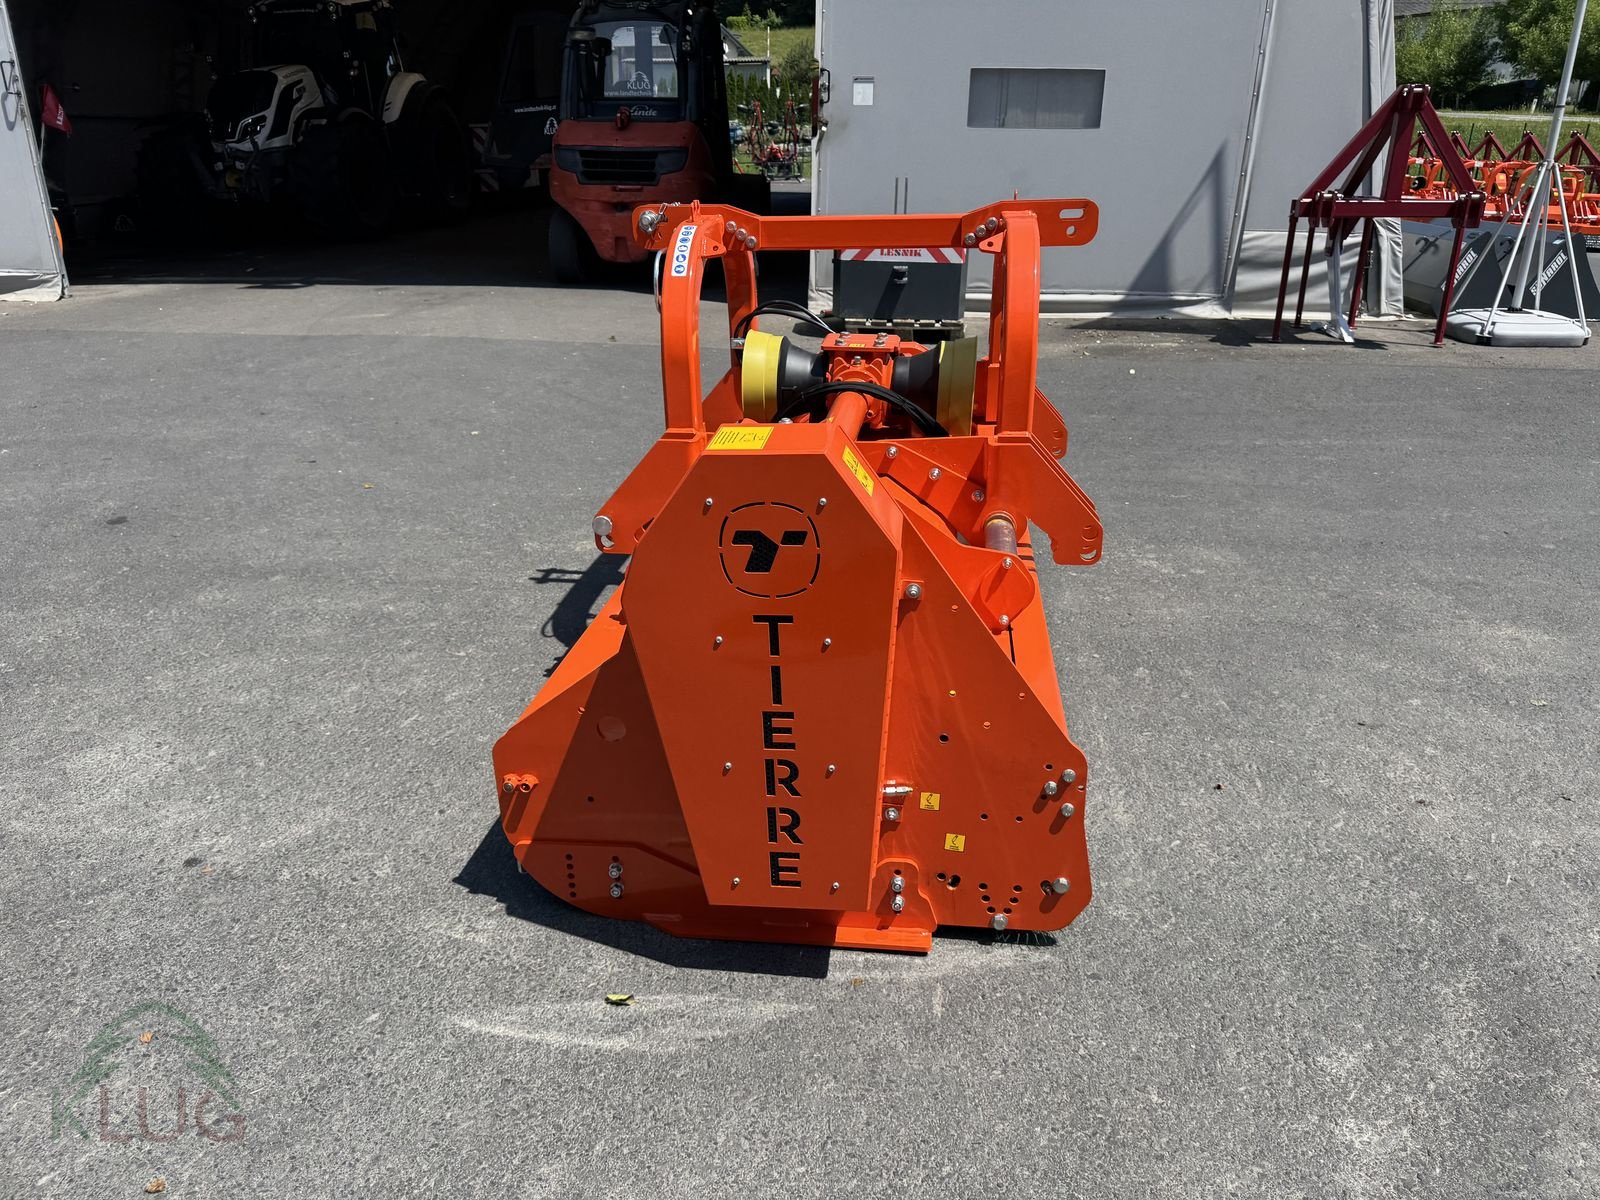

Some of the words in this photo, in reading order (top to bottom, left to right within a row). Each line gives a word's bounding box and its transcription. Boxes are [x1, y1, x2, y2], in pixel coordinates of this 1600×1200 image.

[627, 81, 651, 90] KLUG
[880, 249, 922, 257] LESNIK
[752, 615, 804, 887] TIERRE
